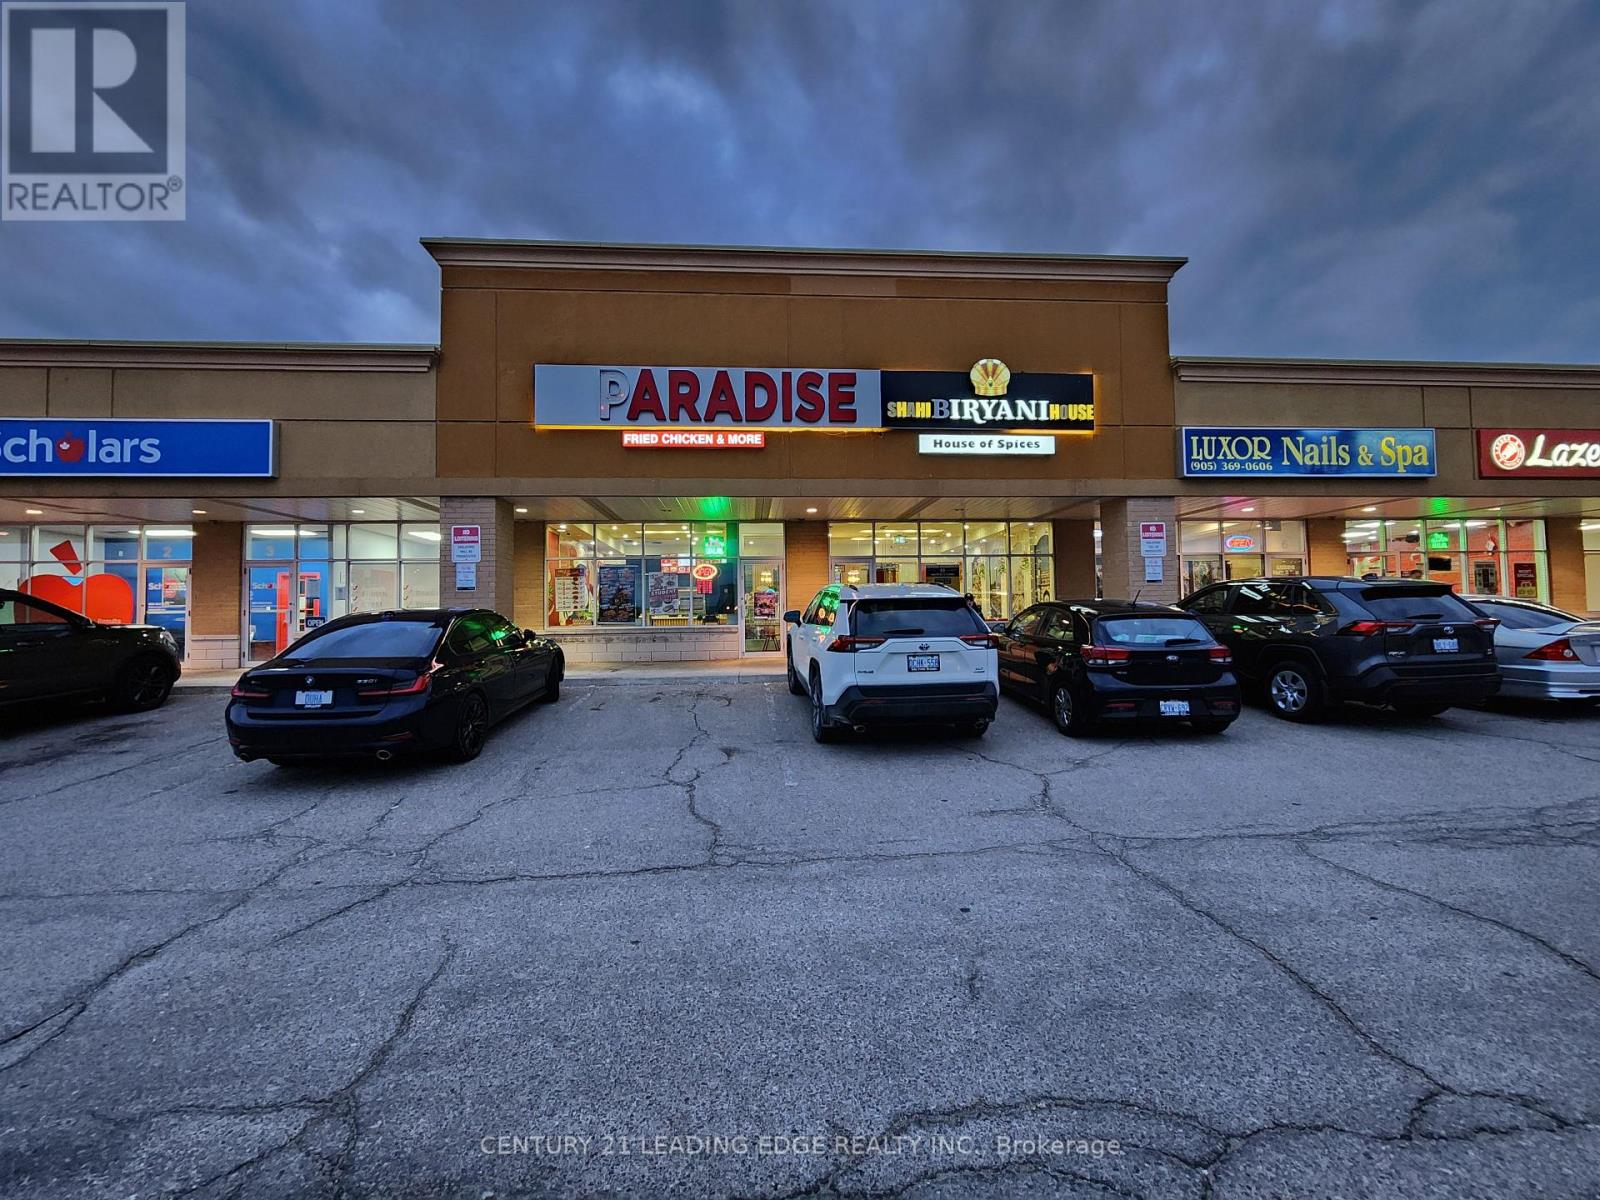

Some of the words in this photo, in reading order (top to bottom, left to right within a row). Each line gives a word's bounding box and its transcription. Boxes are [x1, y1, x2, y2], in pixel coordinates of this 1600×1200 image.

[599, 368, 857, 424] PARADISE
[887, 400, 931, 419] SHAHI
[931, 398, 1050, 425] BIRYANI
[1050, 403, 1094, 421] HOUSE
[623, 433, 659, 446] FRIED
[661, 433, 714, 446] CHICKEN
[716, 434, 725, 446] &
[728, 434, 762, 446] MORE
[933, 438, 975, 450] House
[979, 438, 994, 450] of
[997, 438, 1041, 452] Spices
[1190, 436, 1272, 460] LUXOR
[1524, 433, 1600, 467] Laze
[1190, 461, 1217, 472] (905)
[1221, 461, 1273, 471] 369-0606
[1281, 436, 1351, 466] Nails
[1357, 445, 1375, 466] &
[1380, 436, 1429, 473] Spa
